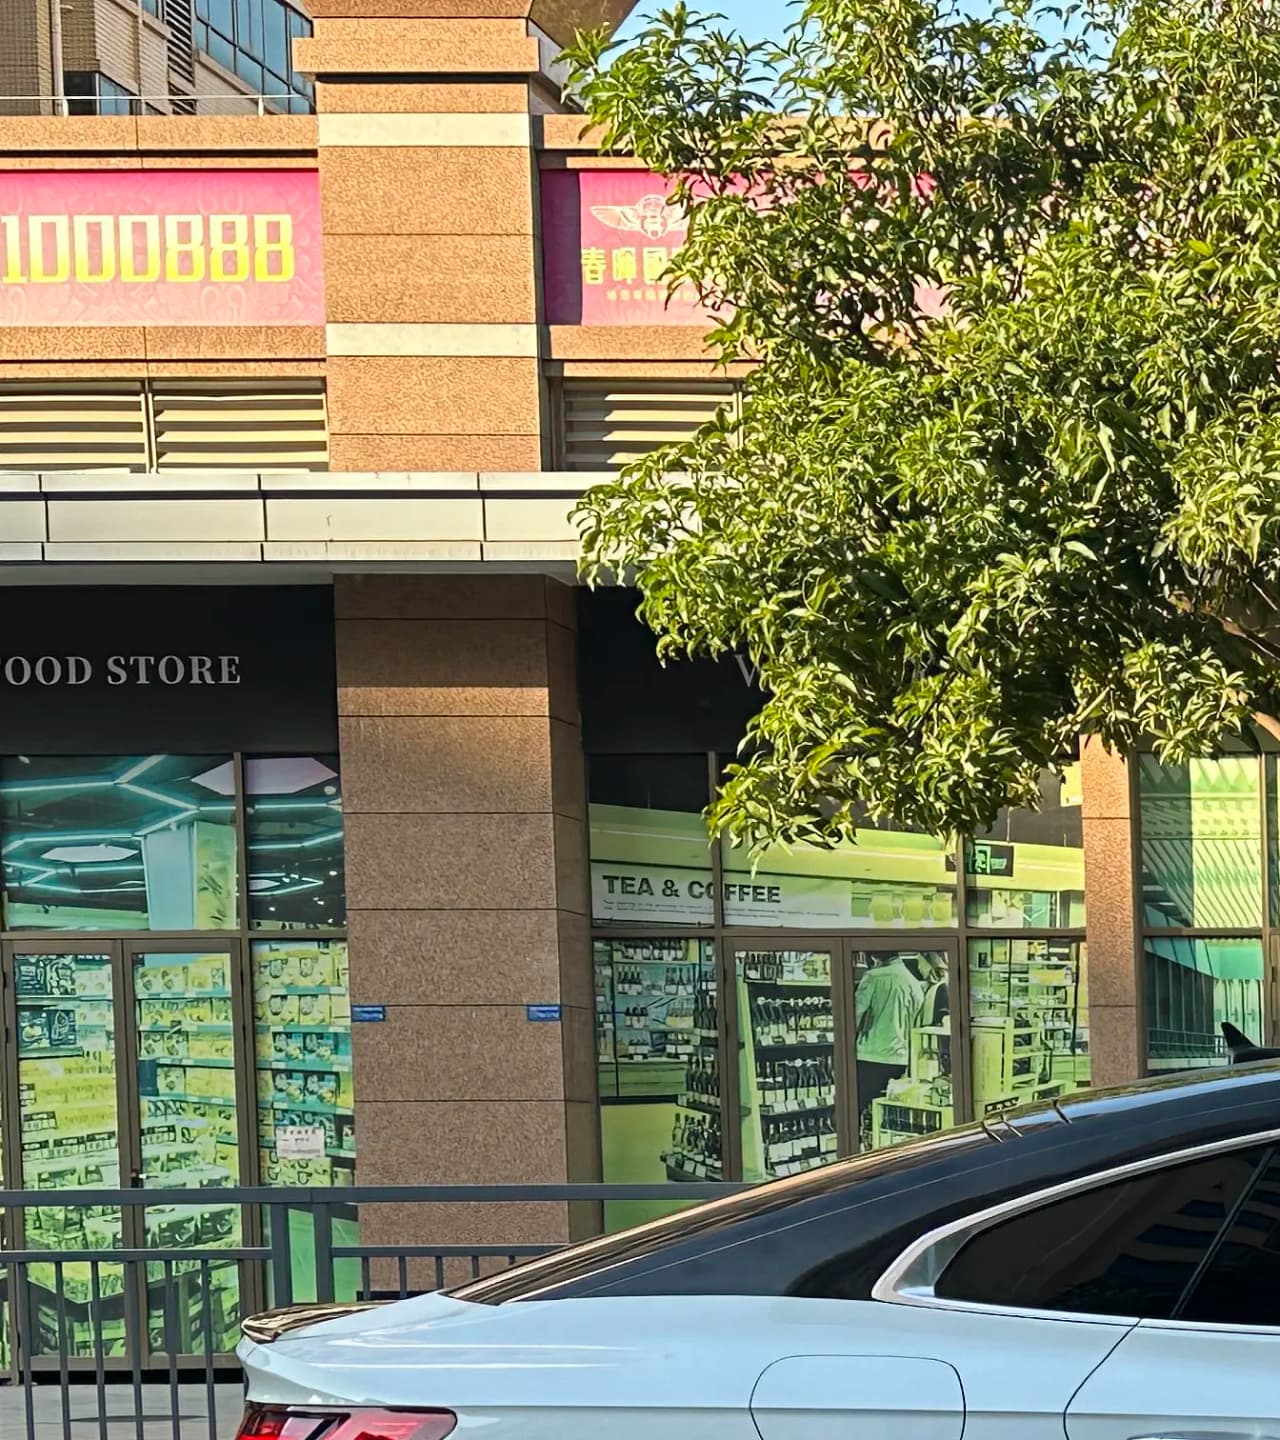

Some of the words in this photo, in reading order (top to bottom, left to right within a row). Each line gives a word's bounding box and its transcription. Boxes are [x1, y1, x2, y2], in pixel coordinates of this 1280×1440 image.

[0, 213, 295, 284] 1000888
[0, 655, 93, 686] OOD
[106, 655, 241, 685] STORE
[602, 874, 655, 897] TEA
[661, 879, 681, 898] &
